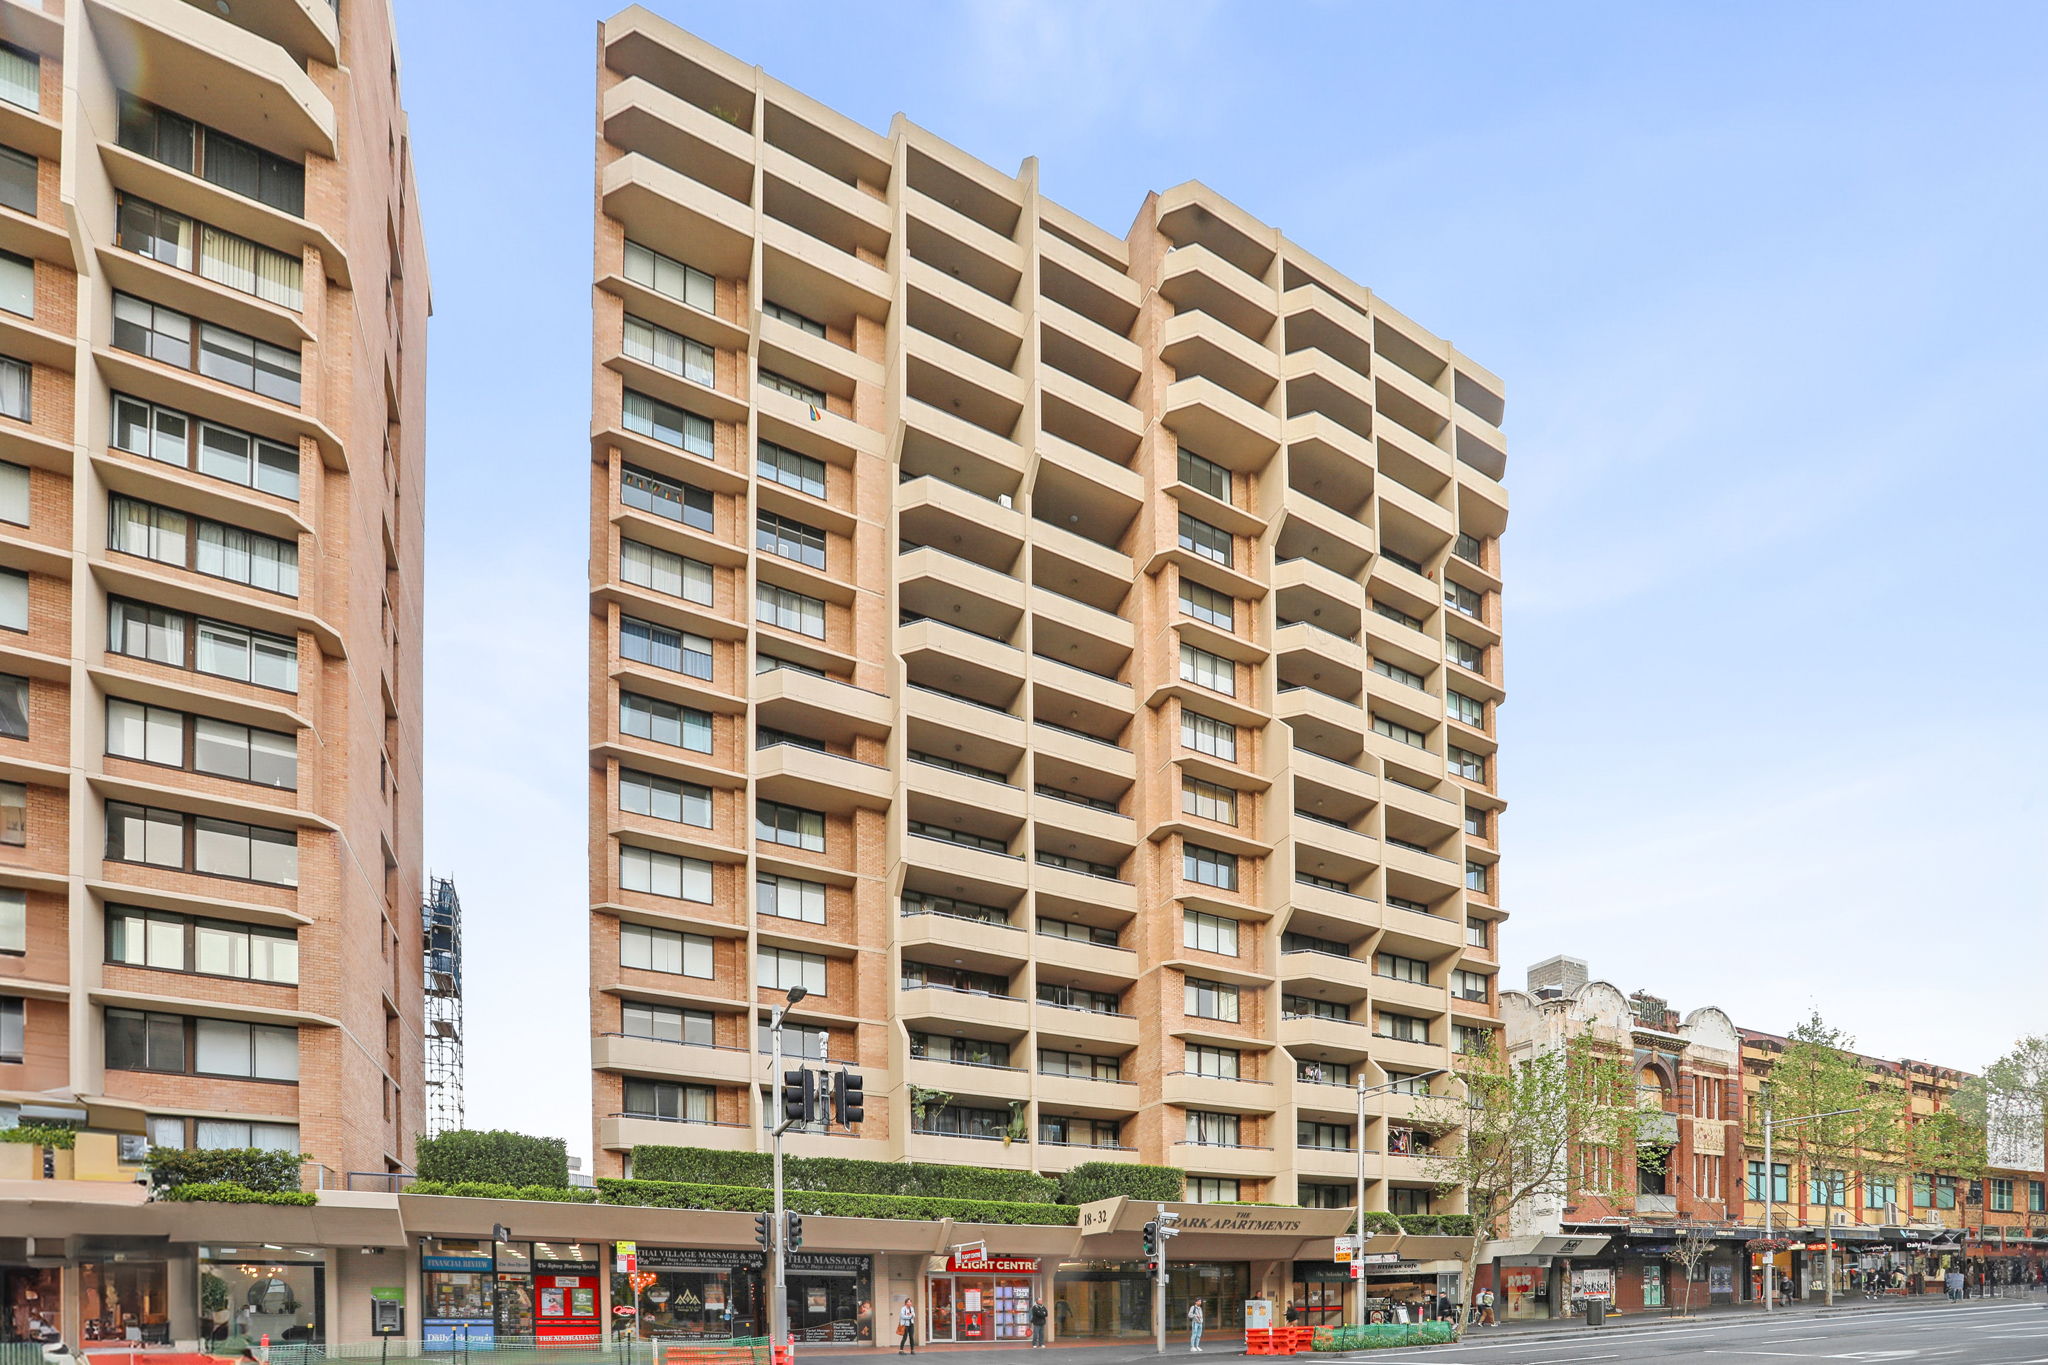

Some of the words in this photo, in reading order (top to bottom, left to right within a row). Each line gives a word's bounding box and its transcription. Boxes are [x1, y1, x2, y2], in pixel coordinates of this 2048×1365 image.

[1084, 1213, 1092, 1226] 18
[1098, 1210, 1107, 1224] 32
[1171, 1217, 1211, 1228] PARK
[1210, 1219, 1301, 1231] APARTMENTS
[637, 1249, 657, 1257] THAI
[659, 1250, 697, 1258] VILLAGE
[699, 1251, 739, 1260] MASSAGE
[749, 1253, 763, 1261] SPA
[788, 1255, 811, 1264] THAI
[814, 1256, 861, 1265] MASSAGE
[428, 1259, 461, 1267] FINANCIAL
[463, 1260, 488, 1268] REVIEW
[955, 1260, 995, 1270] FLIGHT
[996, 1261, 1038, 1270] CENTRE
[613, 1305, 636, 1316] Open
[427, 1333, 449, 1343] Daily
